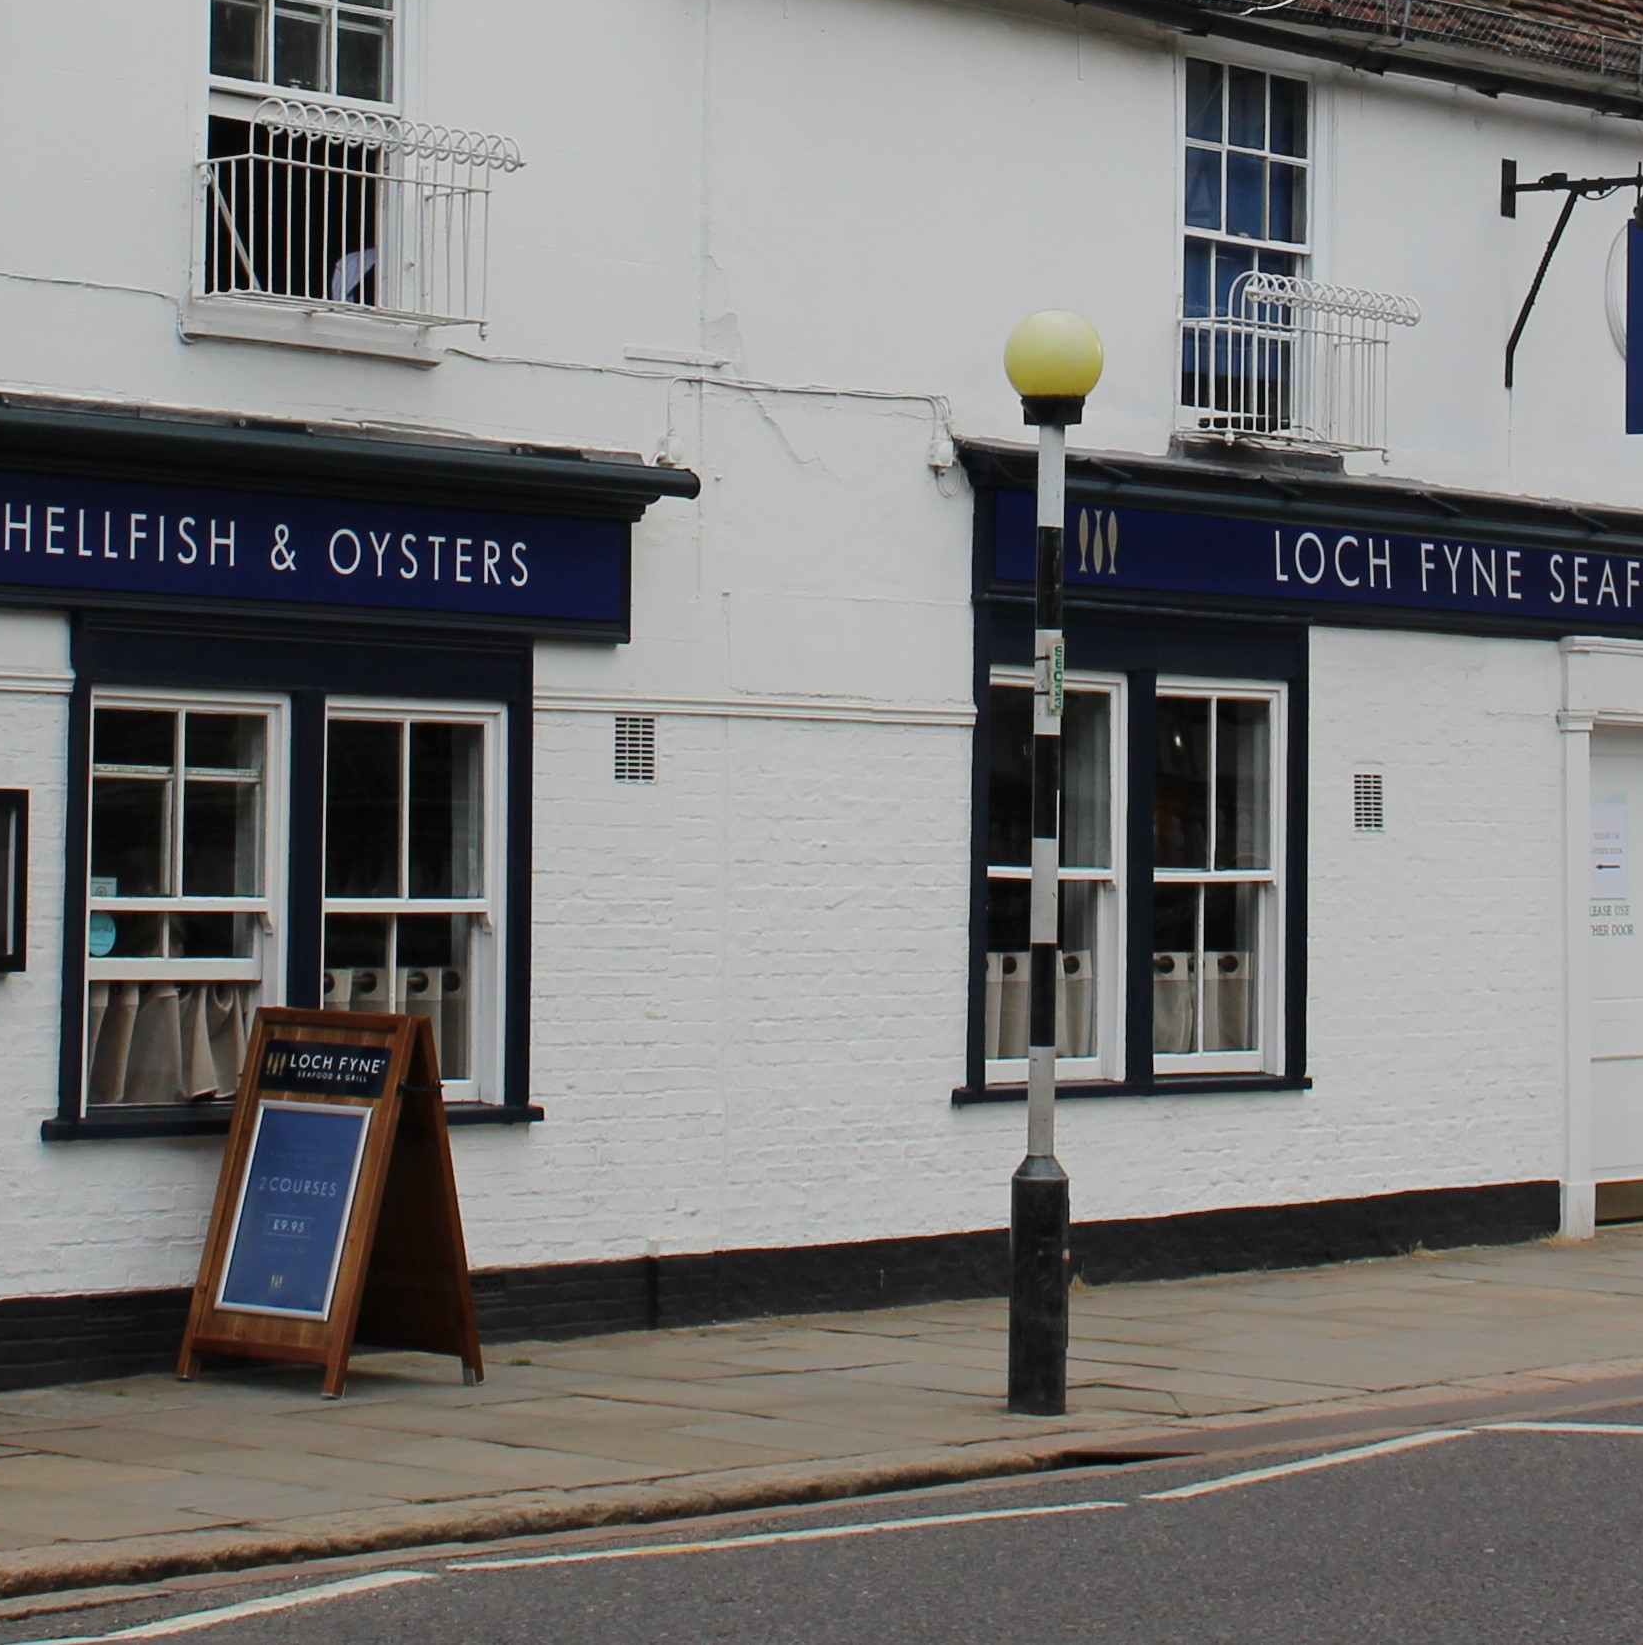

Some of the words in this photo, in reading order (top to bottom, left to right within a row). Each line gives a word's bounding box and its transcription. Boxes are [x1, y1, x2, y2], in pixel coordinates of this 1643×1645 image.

[270, 523, 297, 571] &
[329, 528, 529, 587] OYSTERS
[1275, 530, 1392, 589] LOCH
[1420, 542, 1522, 600] FYNE
[1589, 905, 1612, 917] LEASE
[1615, 904, 1630, 916] USE
[1612, 923, 1634, 937] DOOR
[290, 1054, 333, 1070] LOCH
[297, 1070, 333, 1081] SEAFOOD
[345, 1073, 367, 1083] GRILL
[259, 1176, 267, 1191] 2
[269, 1177, 337, 1197] COURSES
[273, 1219, 305, 1233] £9.95
